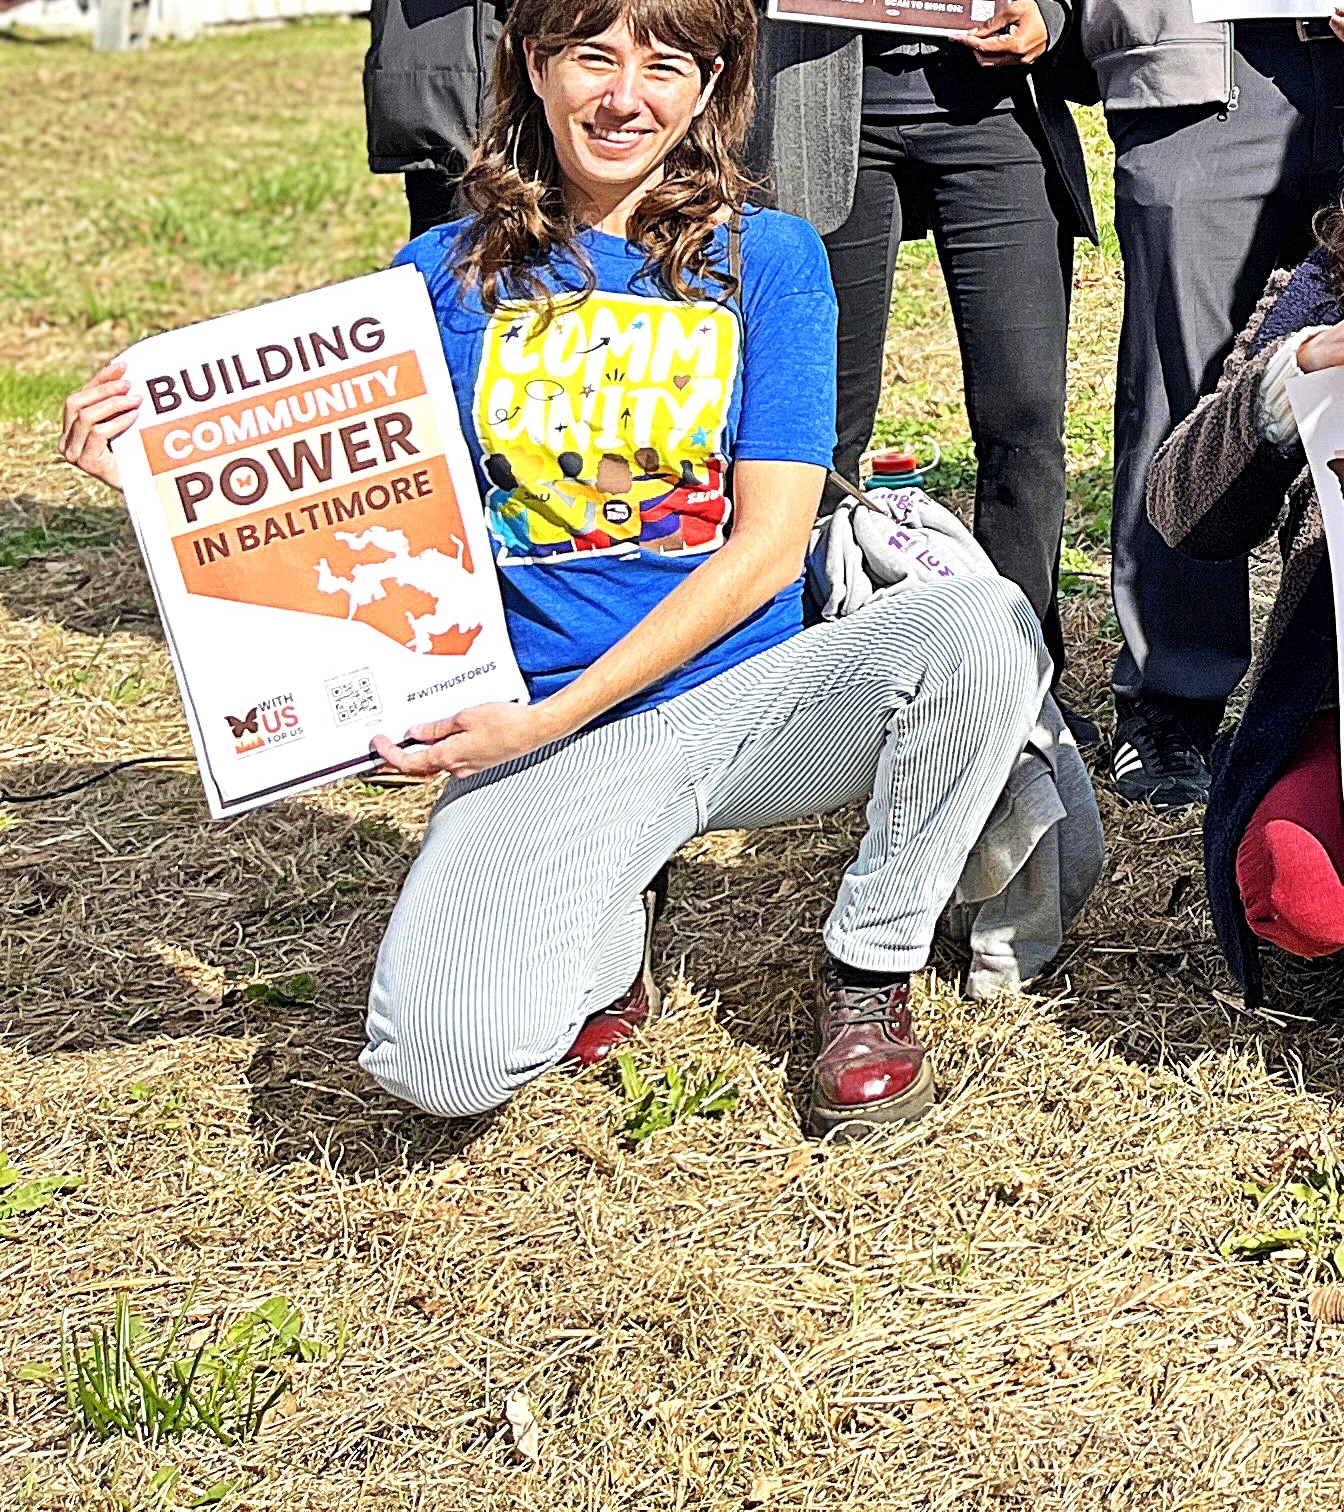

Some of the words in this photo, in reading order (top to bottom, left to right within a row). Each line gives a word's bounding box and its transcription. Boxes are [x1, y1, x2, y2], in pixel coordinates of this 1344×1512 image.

[146, 317, 386, 415] BUILDING
[499, 308, 717, 382] COMM
[163, 365, 400, 459] COMMUNITY
[488, 378, 721, 452] UNITY
[174, 411, 420, 523] POWER
[193, 538, 230, 566] IN
[239, 470, 434, 553] BALTIMORE
[258, 693, 294, 712] WITH
[406, 662, 497, 702] #WITHUSFORUS
[262, 706, 299, 733] US
[268, 732, 287, 744] FOR
[289, 727, 304, 741] US
